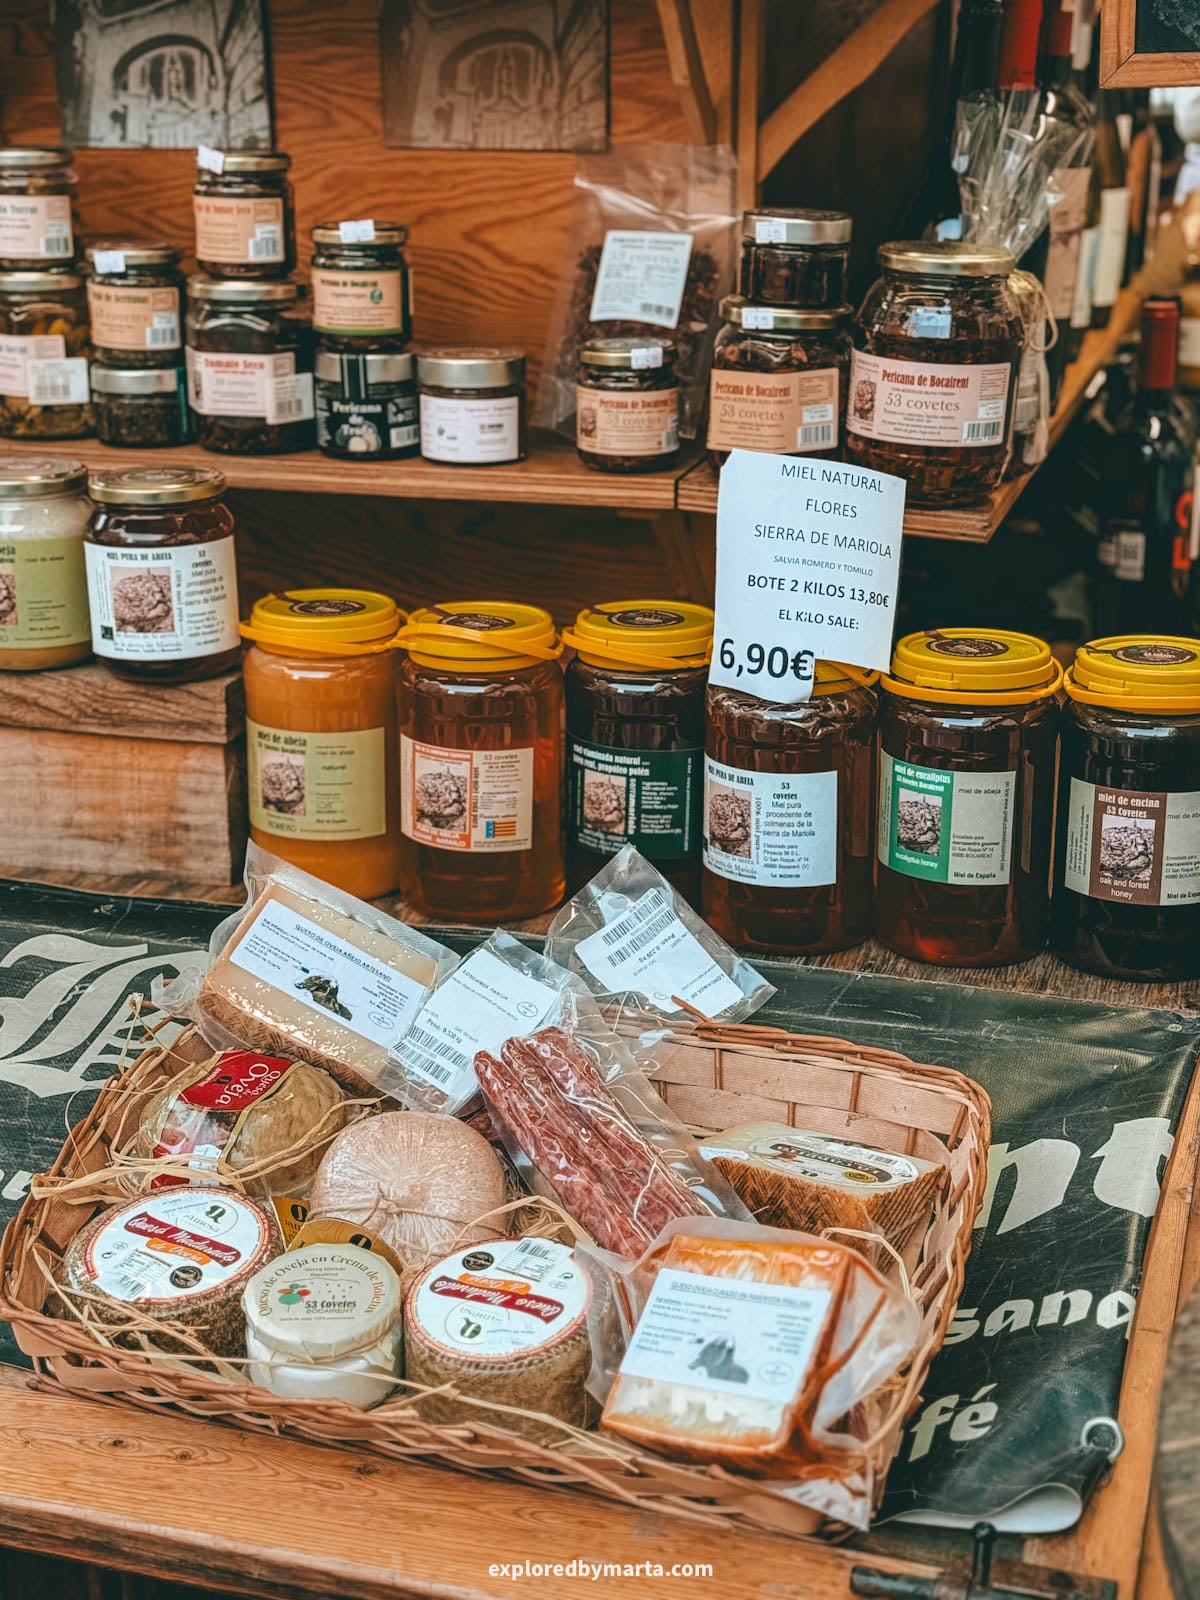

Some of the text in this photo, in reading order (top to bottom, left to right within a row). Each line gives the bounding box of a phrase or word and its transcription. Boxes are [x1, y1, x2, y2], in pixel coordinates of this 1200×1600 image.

[204, 357, 265, 370] Tomate Seco
[882, 370, 969, 389] Pericana de Bocairent
[715, 382, 791, 397] Pericana de Bocairent
[332, 401, 382, 414] Pericana
[885, 393, 960, 411] 53 covetes
[720, 403, 785, 421] 53 covetes
[620, 415, 662, 426] covetes
[781, 463, 883, 493] MIEL NATURAL
[806, 498, 858, 518] FLORES
[754, 524, 892, 558] SIERRA DE MARIOLA
[140, 553, 149, 561] DE
[774, 555, 800, 565] SALVIA
[802, 559, 836, 570] ROMERO
[843, 564, 873, 576] TOMILLO
[747, 575, 889, 608] BOTE 2 KILOS 13,80€
[779, 609, 791, 621] EL
[828, 615, 859, 630] SALE:
[720, 638, 815, 681] 6,90€
[272, 734, 281, 743] de
[284, 734, 307, 747] abeja
[614, 754, 641, 765] natural
[715, 769, 727, 779] PURA
[728, 773, 735, 782] DE
[894, 765, 951, 784] miel de eucaliptus
[781, 782, 790, 790] 53
[983, 788, 1001, 796] abeja
[773, 792, 798, 800] covetes
[1098, 793, 1160, 808] miel de encina
[1107, 805, 1147, 818] 53 Covetes
[764, 820, 794, 828] colmenas
[921, 859, 938, 869] honey
[1100, 877, 1112, 885] oak
[1129, 881, 1149, 889] forest
[1111, 889, 1133, 899] honey
[295, 923, 317, 939] QUESO
[324, 939, 344, 955] OVEJA
[360, 960, 392, 982] ARTESANO
[215, 1063, 269, 1105] Oveja
[251, 1070, 281, 1096] Queso
[129, 1216, 236, 1262] Queso Madurado
[150, 1241, 206, 1262] de Oveja
[258, 1254, 386, 1317] Queso de Oveja en Crema de Boletus
[470, 1276, 526, 1291] de Oveja
[305, 1300, 357, 1309] 53 Covetes
[434, 1280, 561, 1317] Queso Madurado
